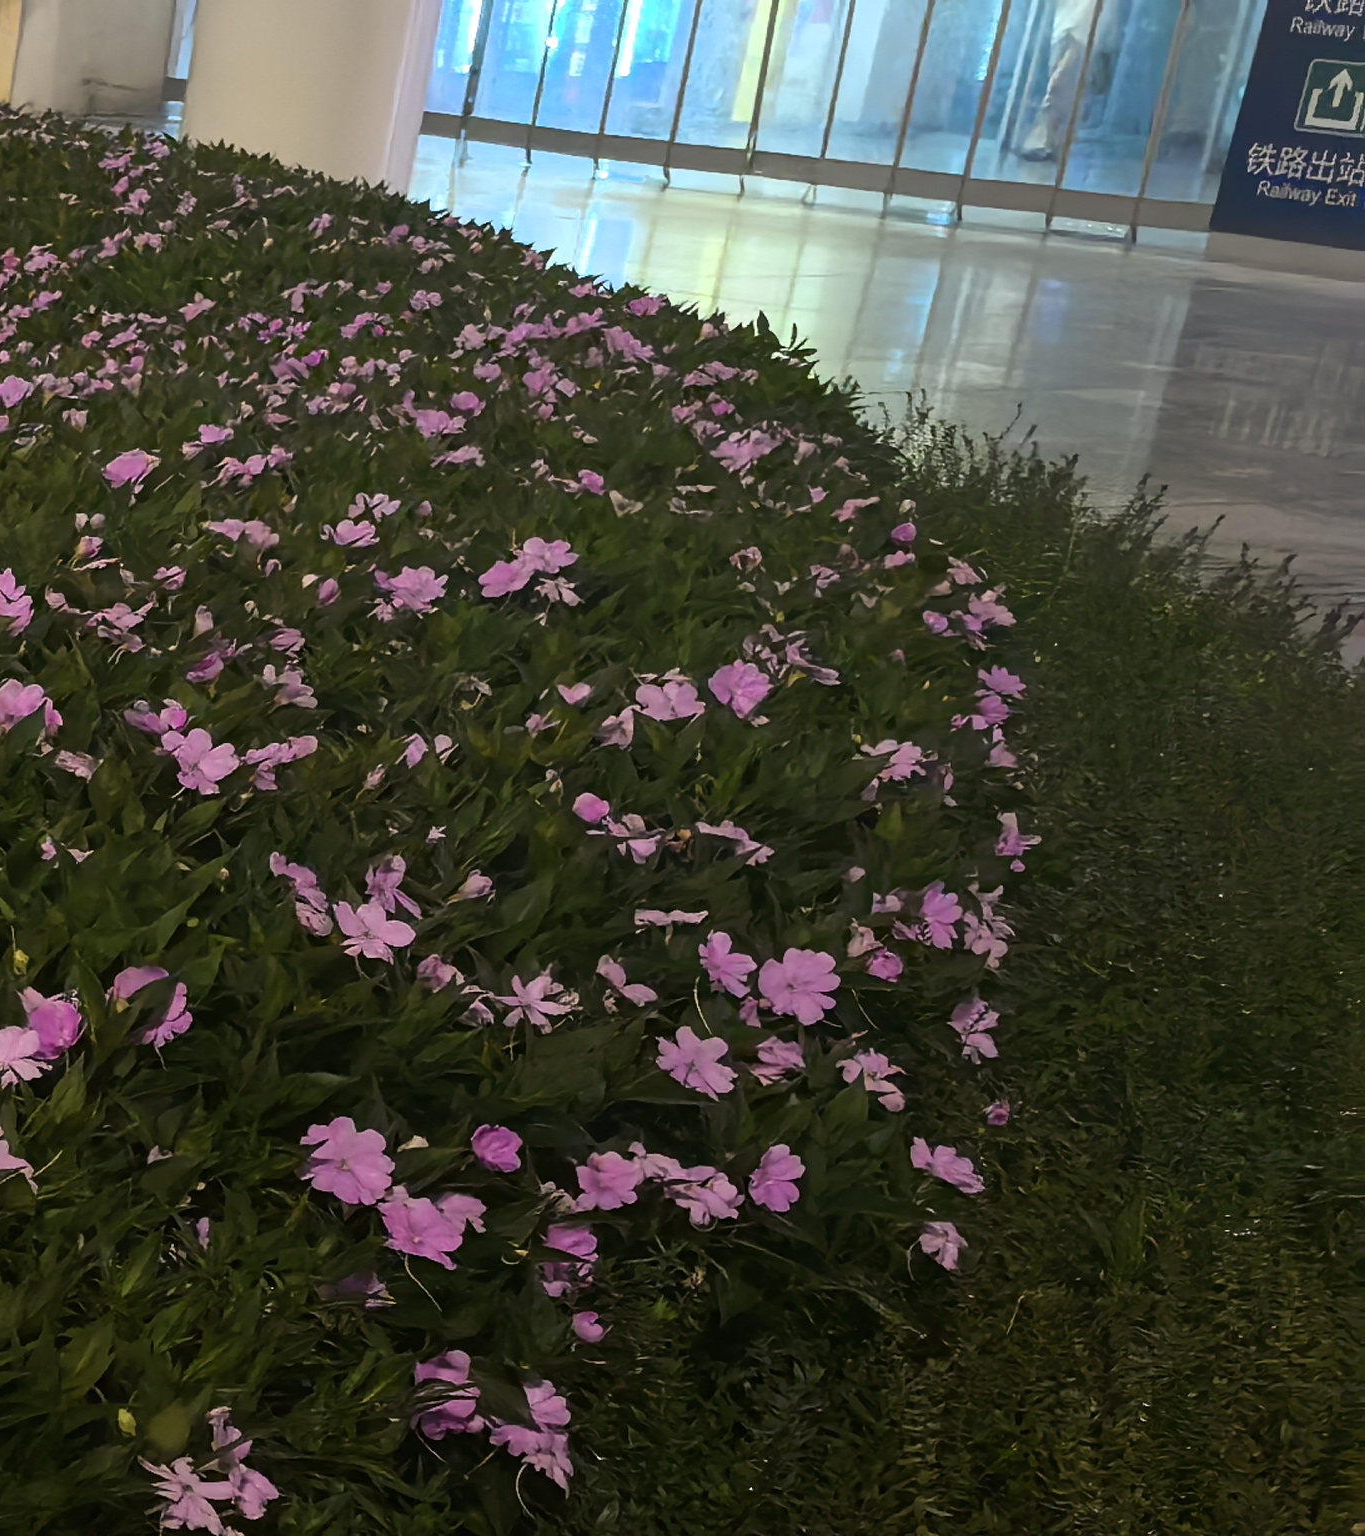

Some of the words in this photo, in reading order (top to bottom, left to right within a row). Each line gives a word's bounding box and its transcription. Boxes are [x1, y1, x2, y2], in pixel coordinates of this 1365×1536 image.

[1290, 16, 1356, 42] Railway
[1247, 142, 1365, 186] 铁路出站
[1257, 180, 1322, 206] Railway
[1325, 188, 1357, 206] Exit
